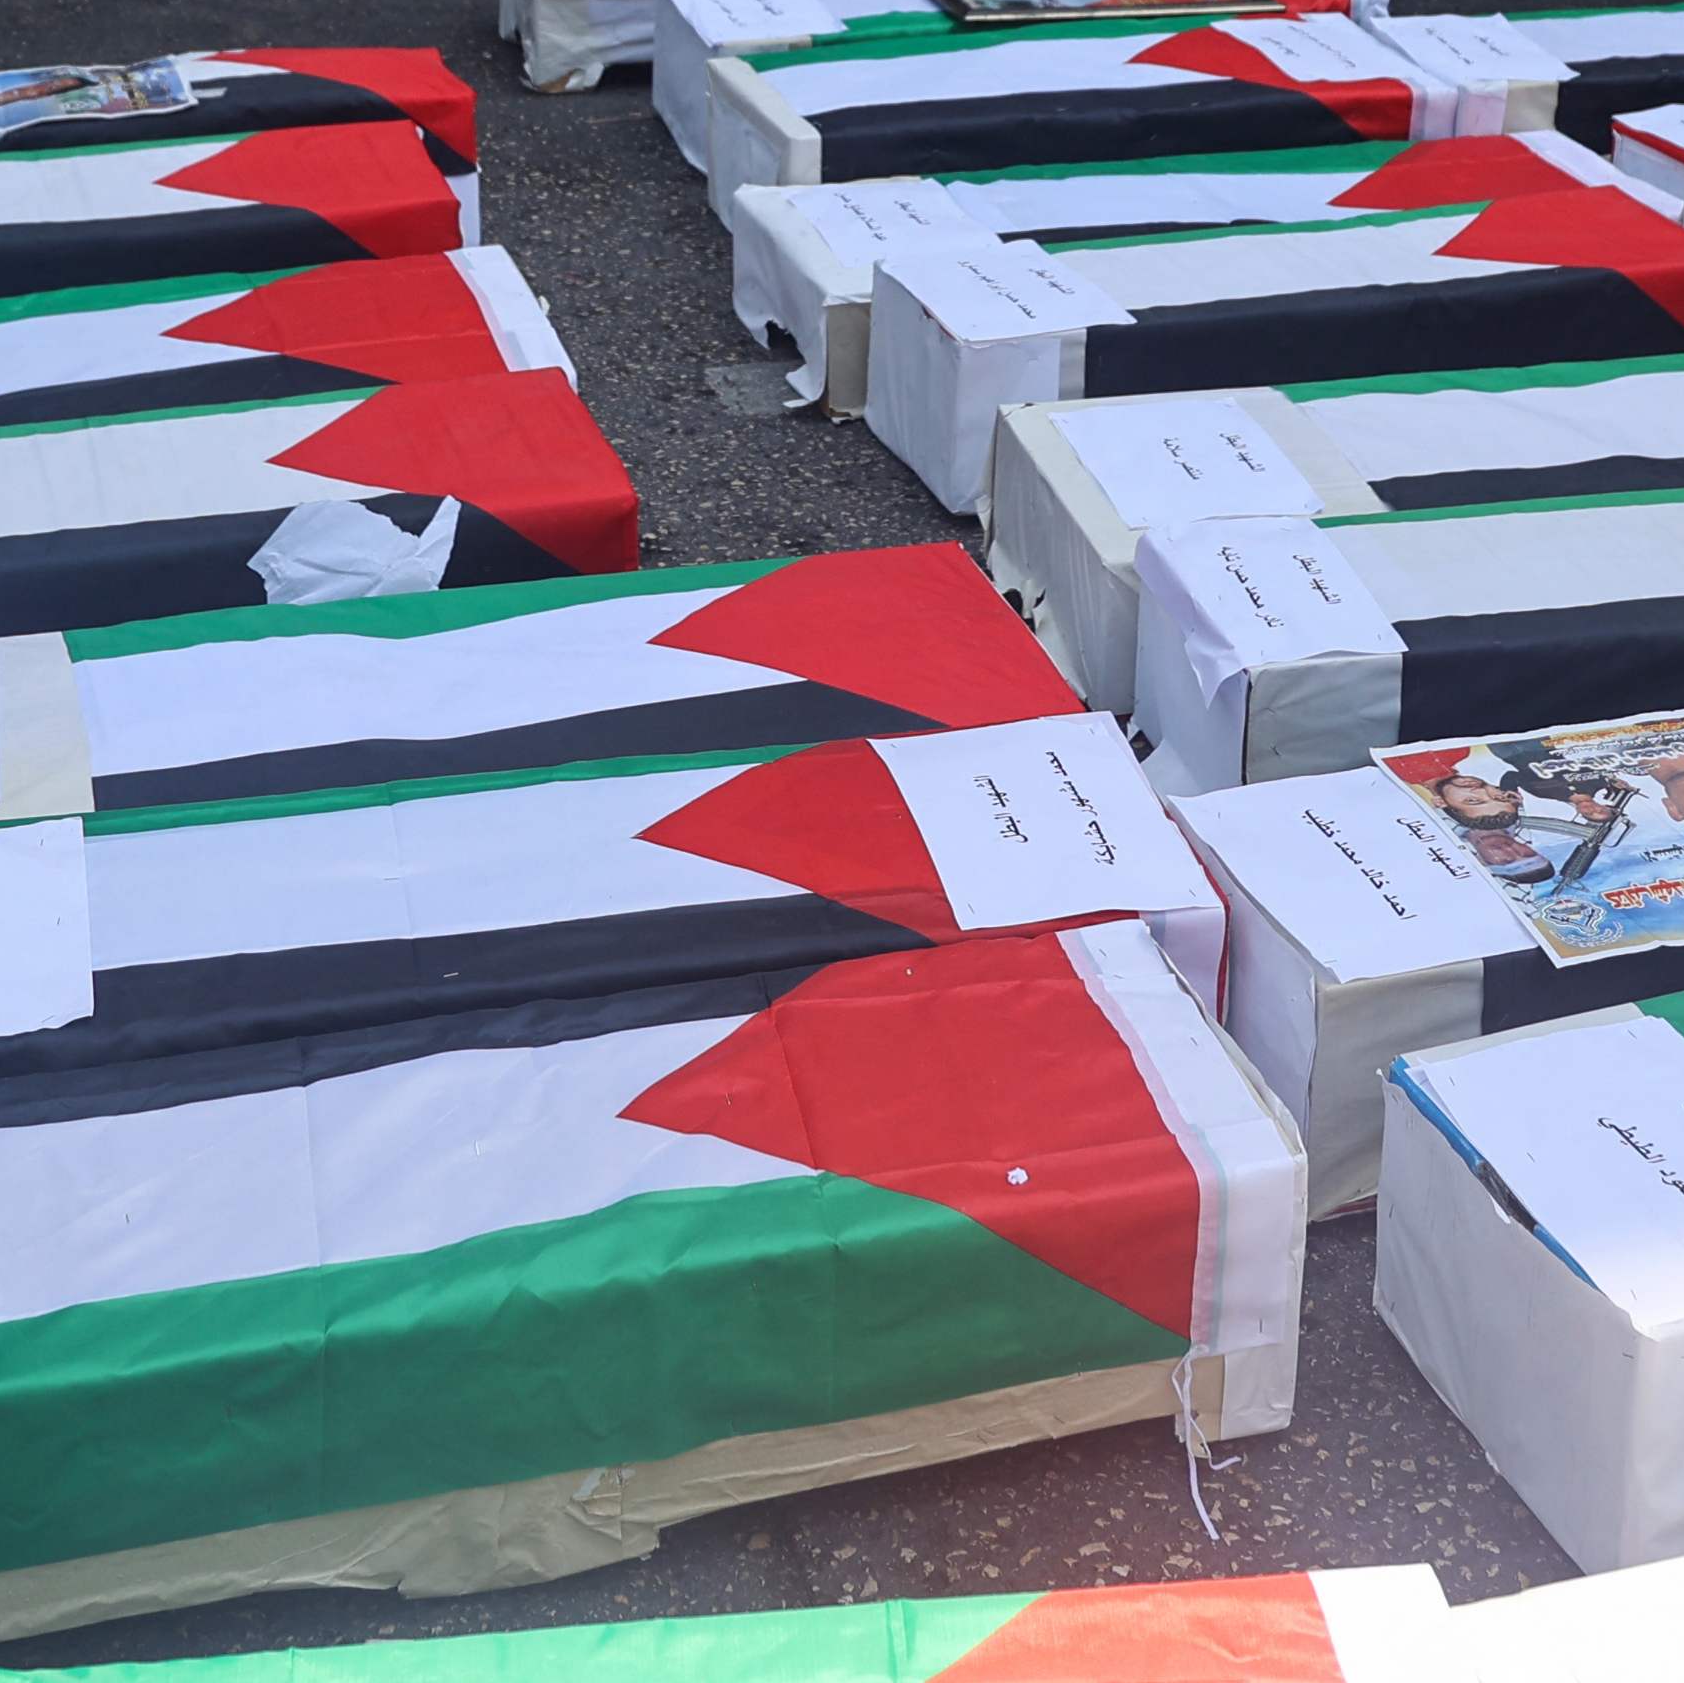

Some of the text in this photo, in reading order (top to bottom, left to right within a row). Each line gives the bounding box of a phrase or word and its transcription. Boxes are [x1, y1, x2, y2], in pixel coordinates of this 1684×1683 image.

[1163, 438, 1202, 480] منتصر سلامة
[1220, 434, 1264, 470] الشهيد البطل
[1226, 565, 1248, 583] حسن
[1293, 555, 1341, 604] الشهيد البطل
[1245, 587, 1264, 608] محمد
[974, 776, 1028, 842] الشهيد البطل
[1046, 752, 1116, 865] محمد مشهور حشايكة
[1303, 810, 1417, 919] احمد خالد محمد خطيب
[1397, 819, 1470, 879] الشهيد البطل
[1594, 881, 1662, 912] كتائب
[1597, 1118, 1665, 1163] الطيطي
